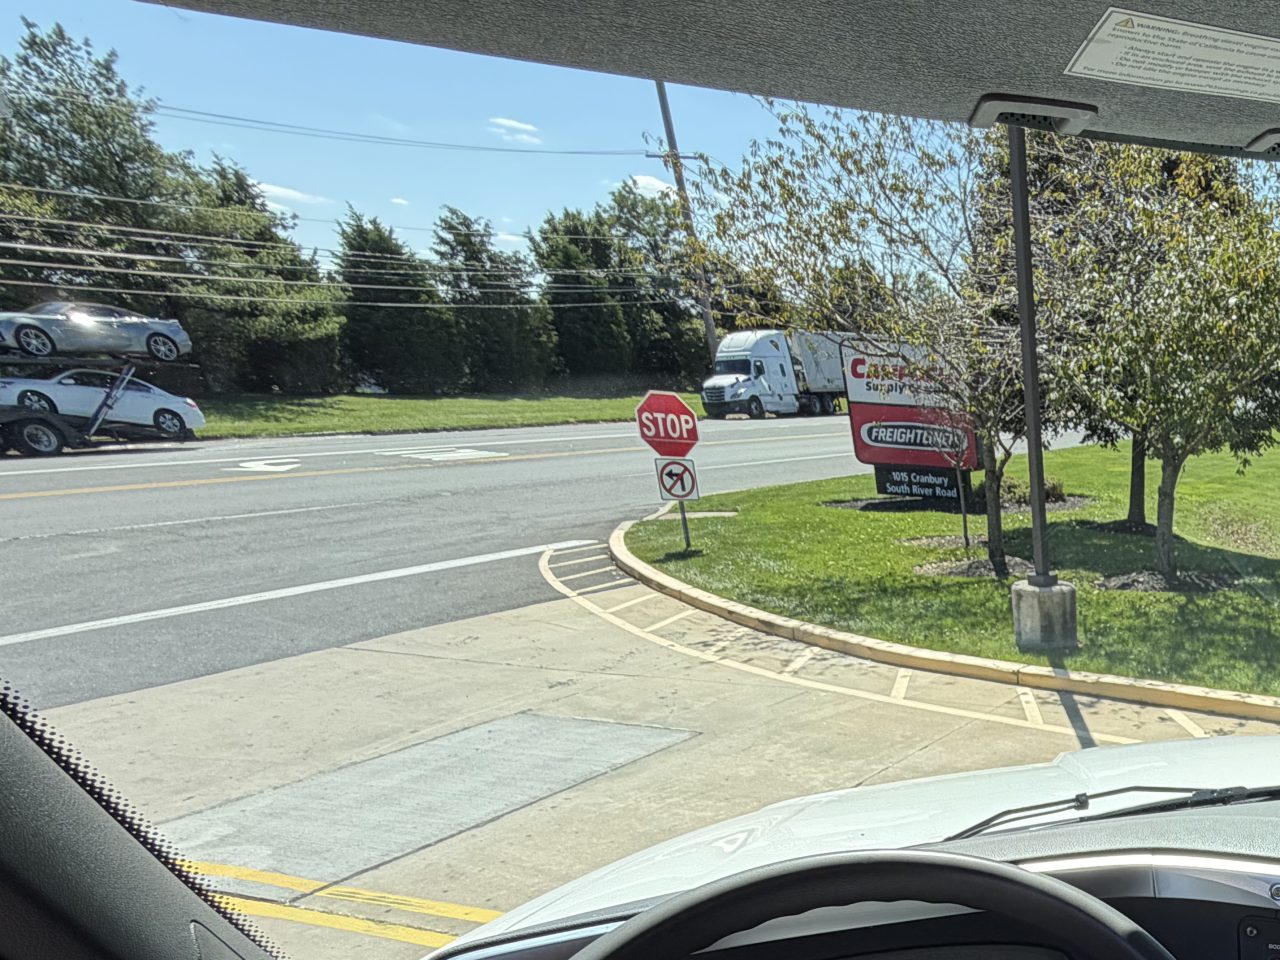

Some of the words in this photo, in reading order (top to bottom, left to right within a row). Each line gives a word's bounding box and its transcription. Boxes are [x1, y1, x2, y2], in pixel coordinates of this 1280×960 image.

[641, 411, 694, 439] STOP
[892, 472, 909, 482] 1015
[910, 472, 948, 487] Cranbury
[886, 483, 910, 494] South
[912, 485, 933, 496] River
[935, 487, 958, 498] Road
